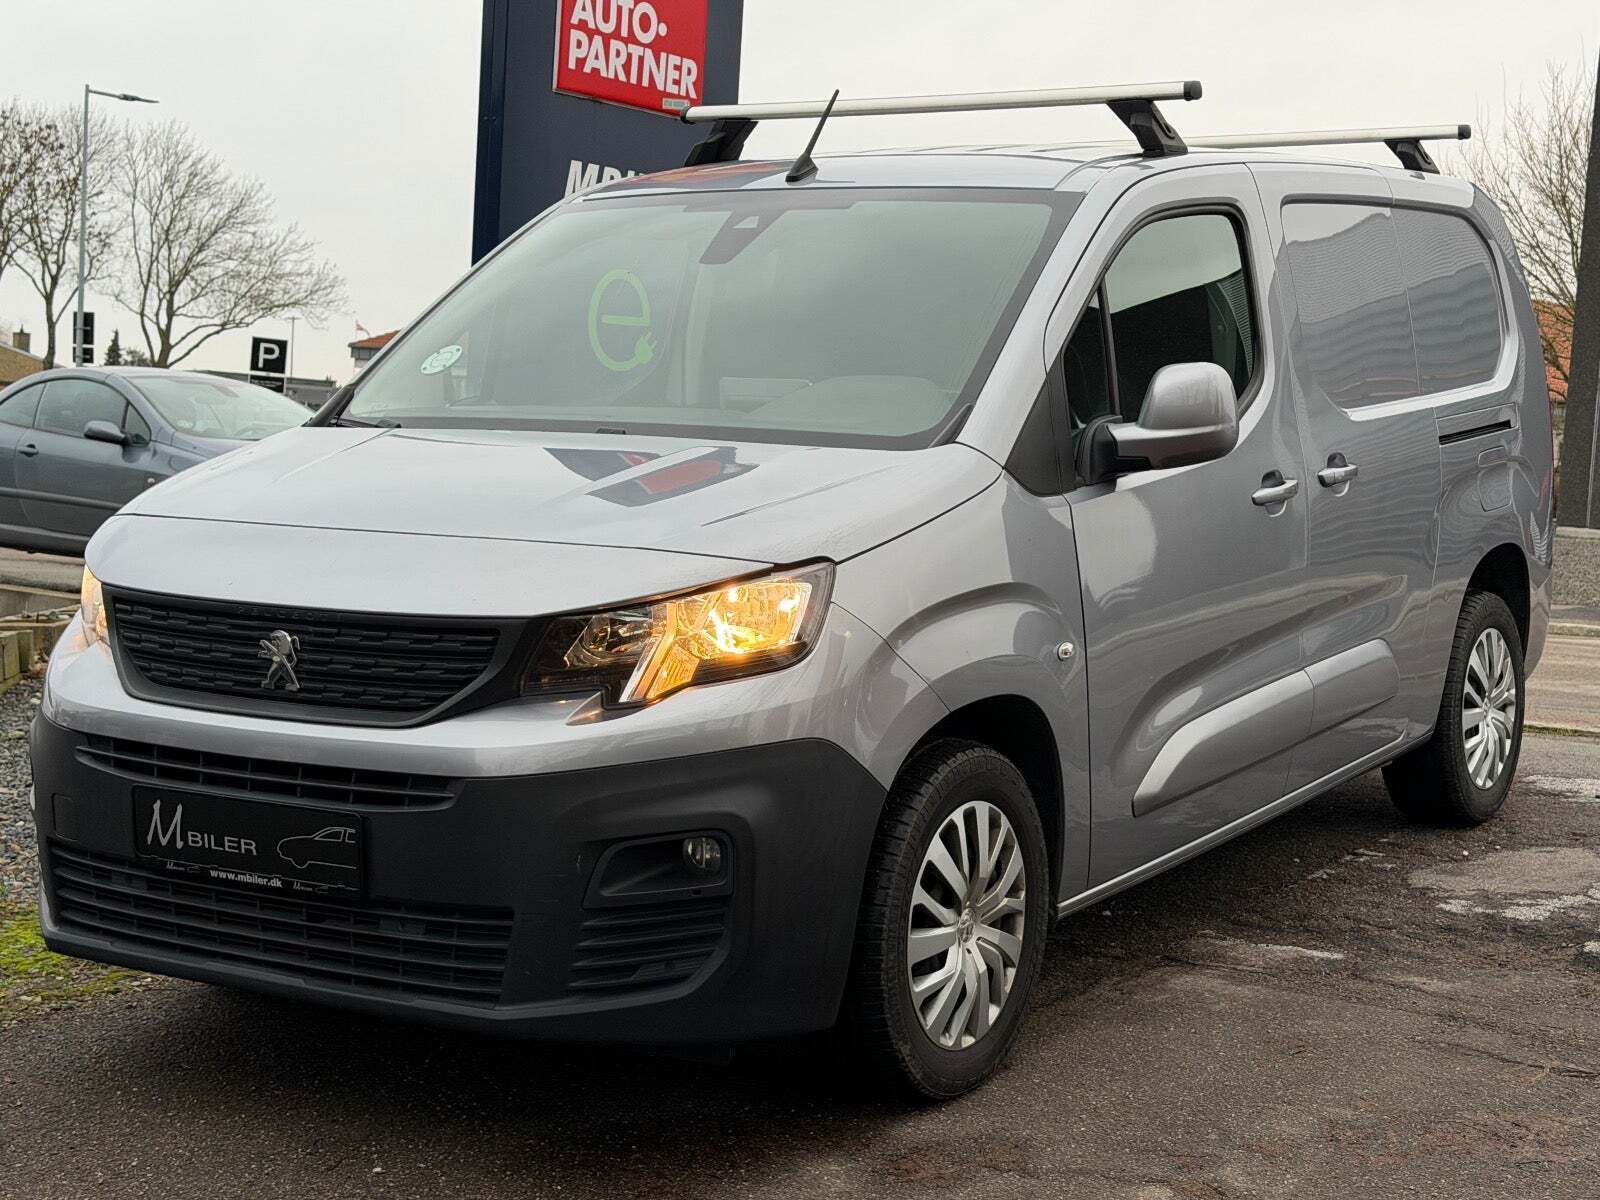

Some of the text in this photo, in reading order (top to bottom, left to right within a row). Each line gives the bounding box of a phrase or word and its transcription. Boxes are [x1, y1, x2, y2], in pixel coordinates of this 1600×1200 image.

[568, 29, 698, 99] PARTNER
[258, 342, 280, 368] P
[209, 868, 283, 888] www.mbiler.dk
